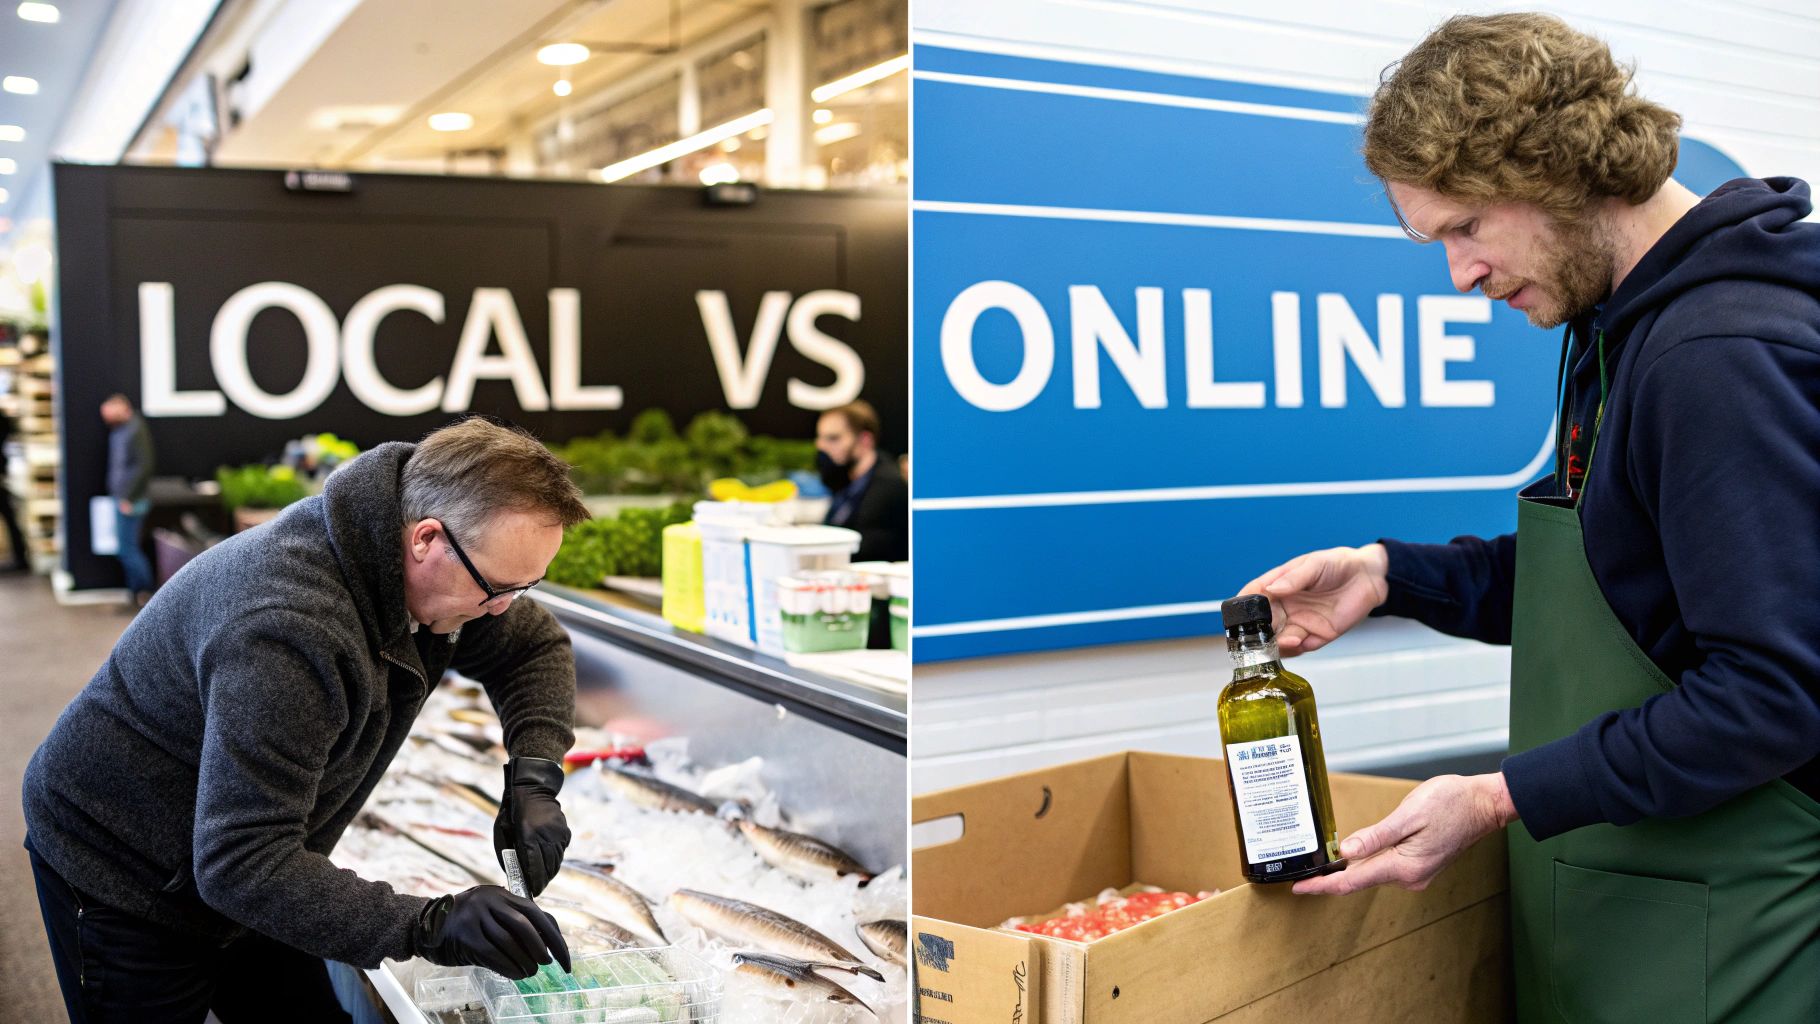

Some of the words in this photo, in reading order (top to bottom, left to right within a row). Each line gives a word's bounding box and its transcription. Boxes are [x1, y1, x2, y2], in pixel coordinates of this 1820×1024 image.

[138, 281, 622, 419] LOCAL
[698, 290, 864, 409] VS
[940, 280, 1495, 411] ONLINE
